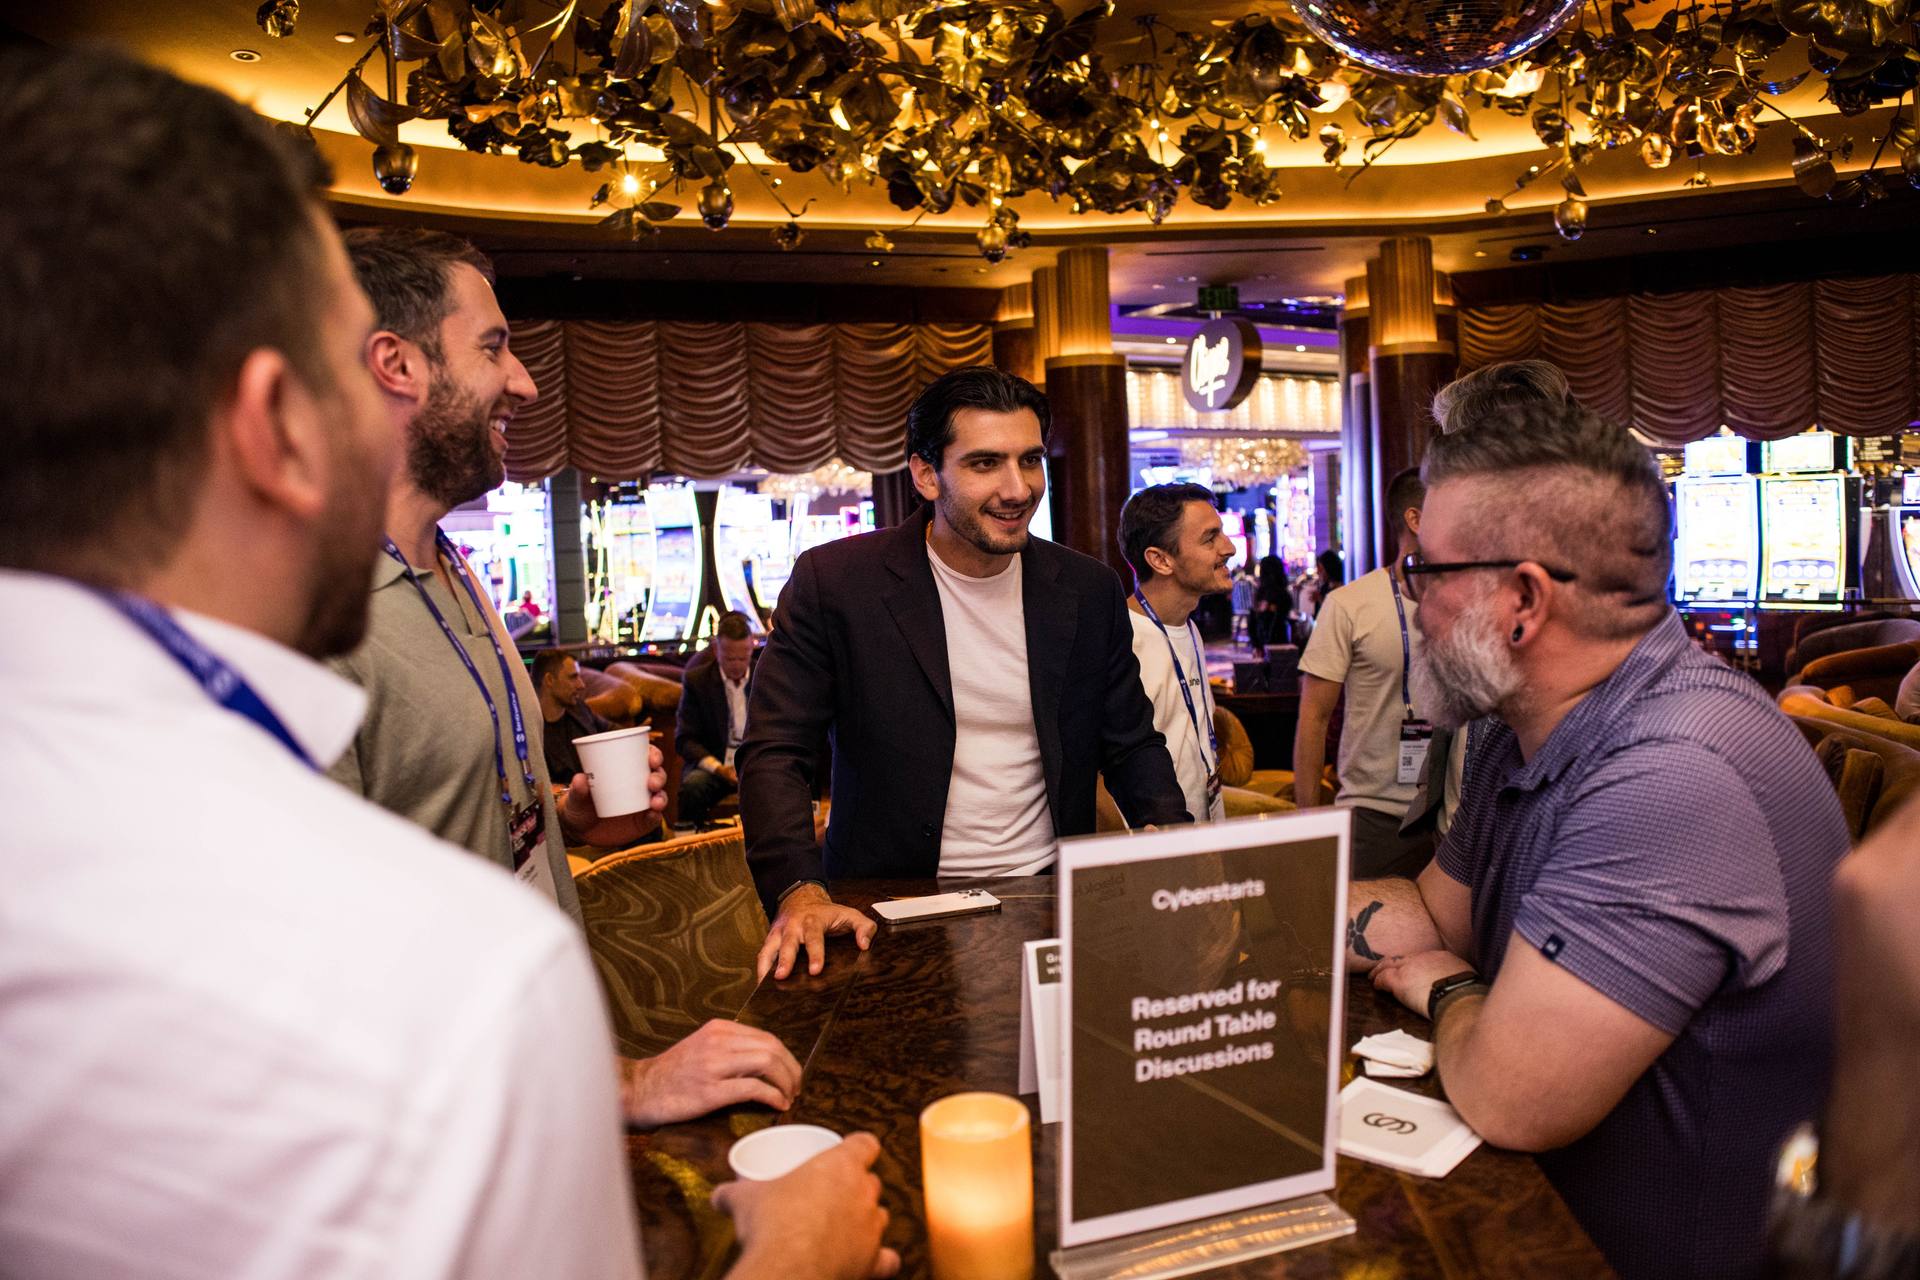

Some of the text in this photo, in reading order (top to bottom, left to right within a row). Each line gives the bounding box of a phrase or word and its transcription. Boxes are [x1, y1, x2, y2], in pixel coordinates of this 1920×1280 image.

[1152, 879, 1265, 912] Cyberstarts
[1131, 978, 1281, 1021] Reserved for
[1134, 1008, 1276, 1052] Round Table
[1135, 1042, 1274, 1082] Discussions
